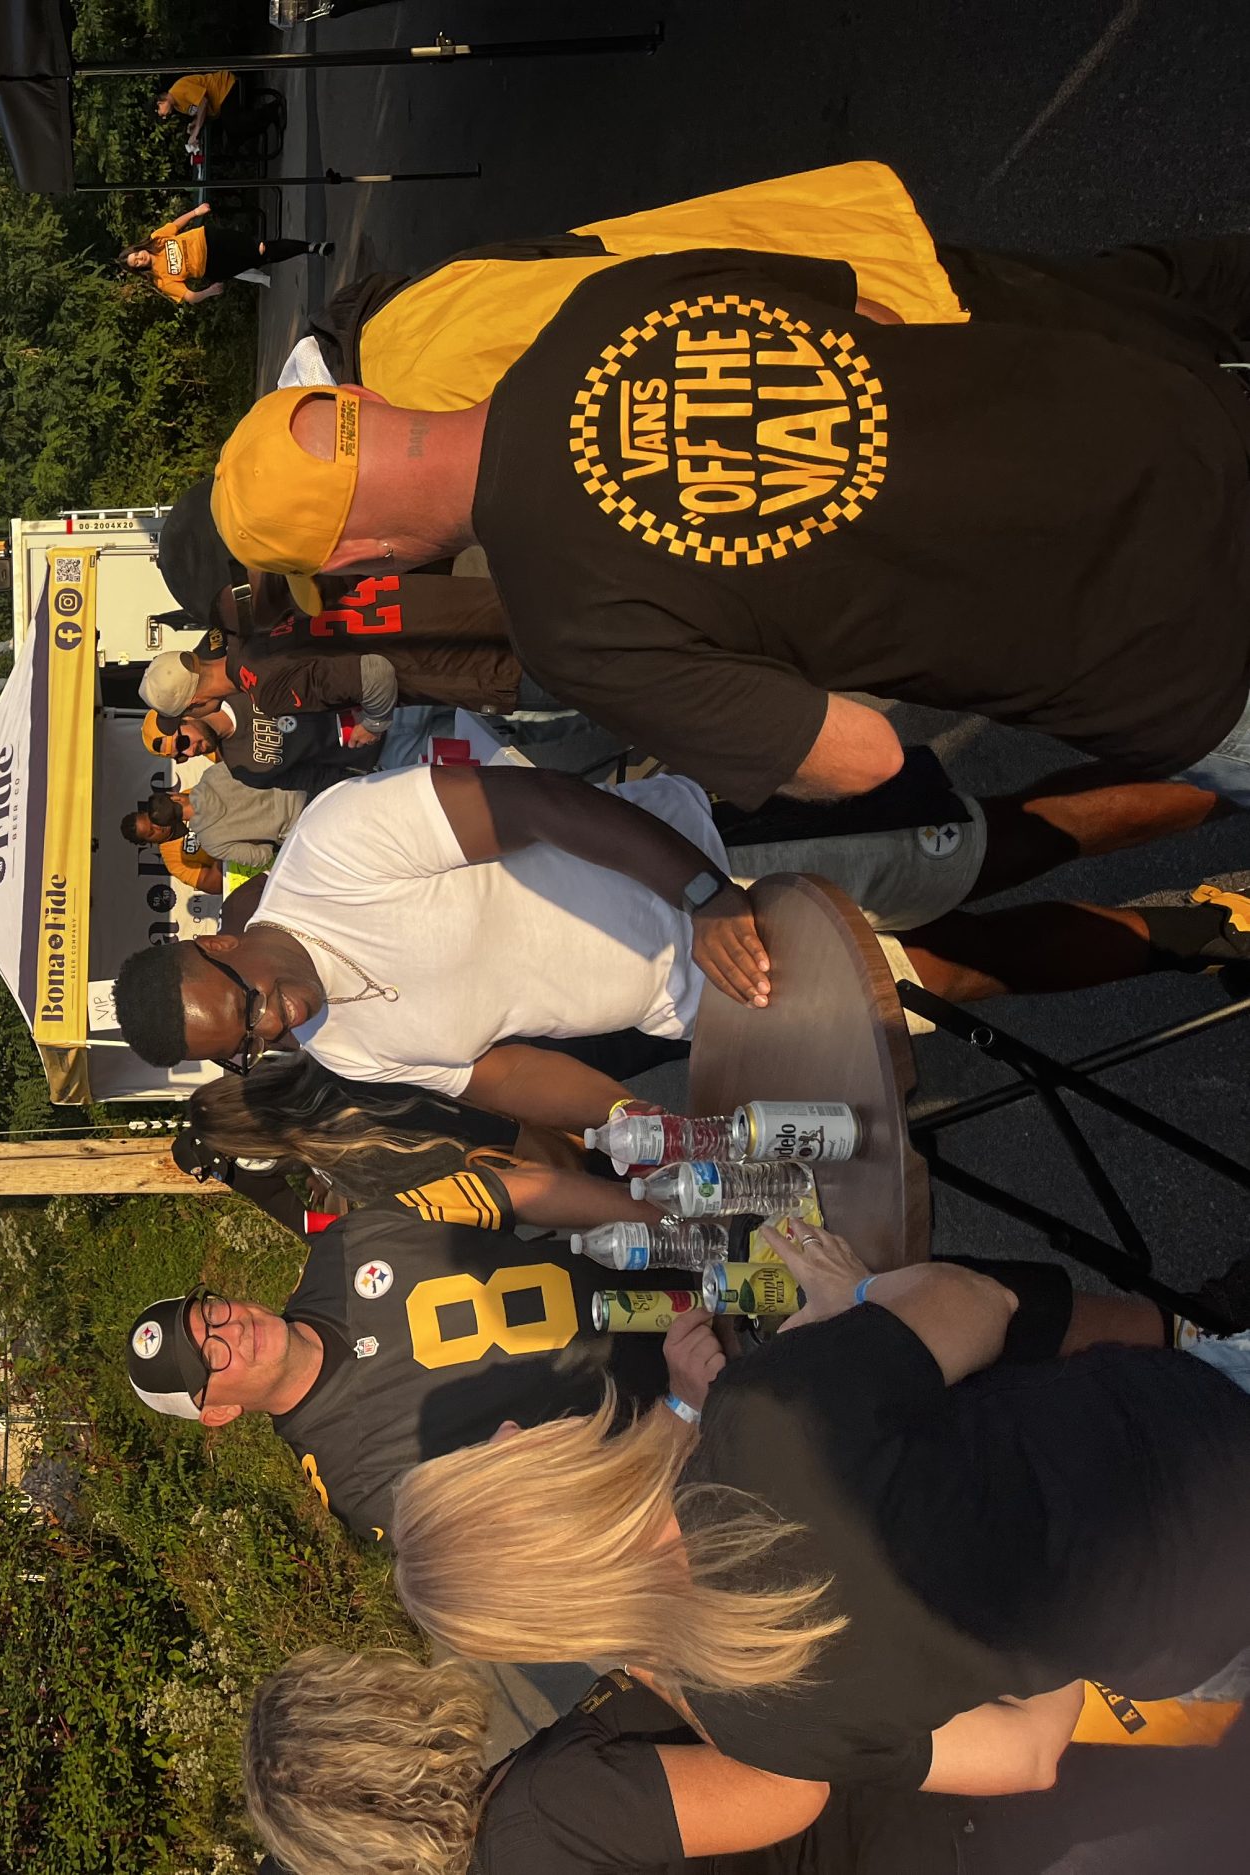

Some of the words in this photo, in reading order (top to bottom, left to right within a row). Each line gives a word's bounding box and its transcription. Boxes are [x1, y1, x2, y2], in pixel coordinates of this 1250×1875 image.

[167, 240, 178, 274] GAMEDAY
[674, 328, 753, 430] THE
[620, 378, 669, 481] VANS
[252, 704, 283, 765] STEEL
[14, 778, 20, 795] CO
[44, 874, 66, 931] Fide
[41, 953, 65, 1022] Bona
[92, 996, 110, 1020] VIP
[774, 1124, 796, 1160] odelo
[405, 1262, 579, 1369] 8
[757, 1269, 779, 1312] Simply
[1121, 1708, 1138, 1722] A
